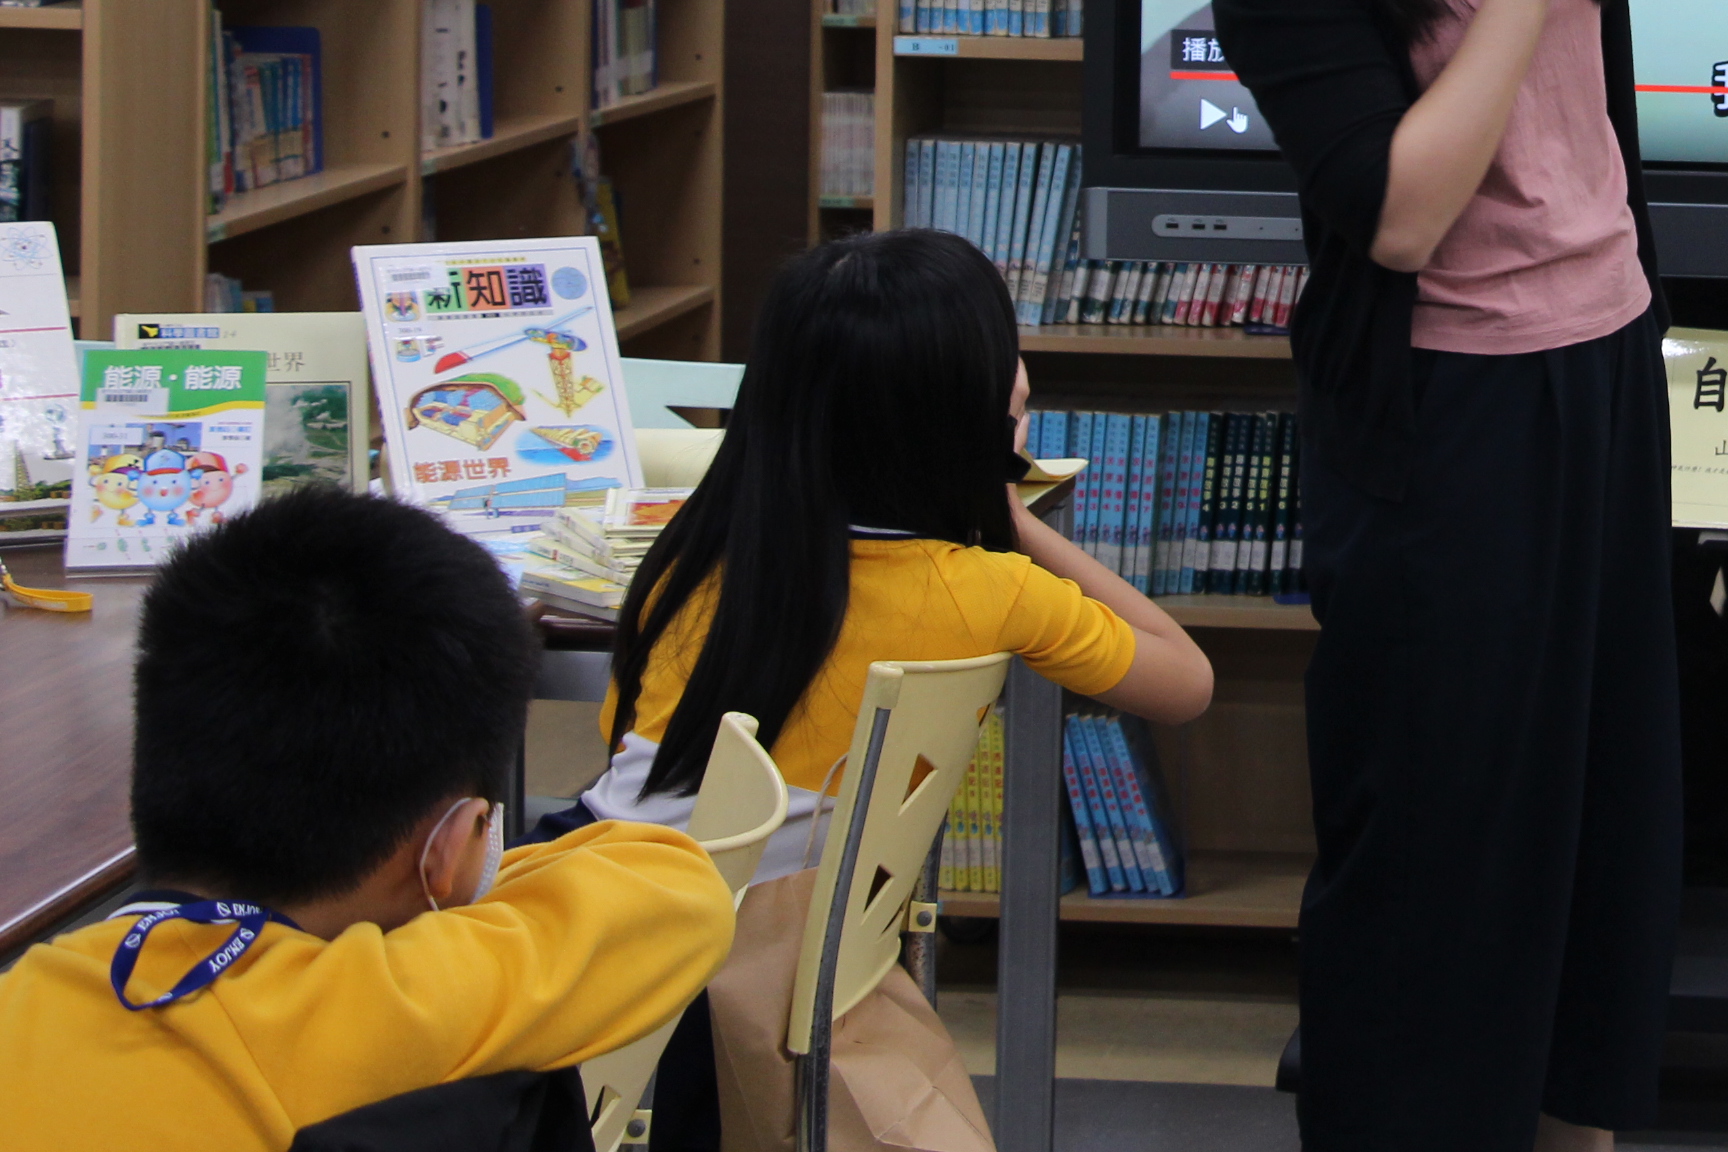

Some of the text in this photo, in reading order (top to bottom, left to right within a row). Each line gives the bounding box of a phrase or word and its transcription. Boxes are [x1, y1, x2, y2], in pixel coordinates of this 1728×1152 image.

[412, 456, 512, 484] 能源世界
[208, 938, 246, 974] ENJOY
